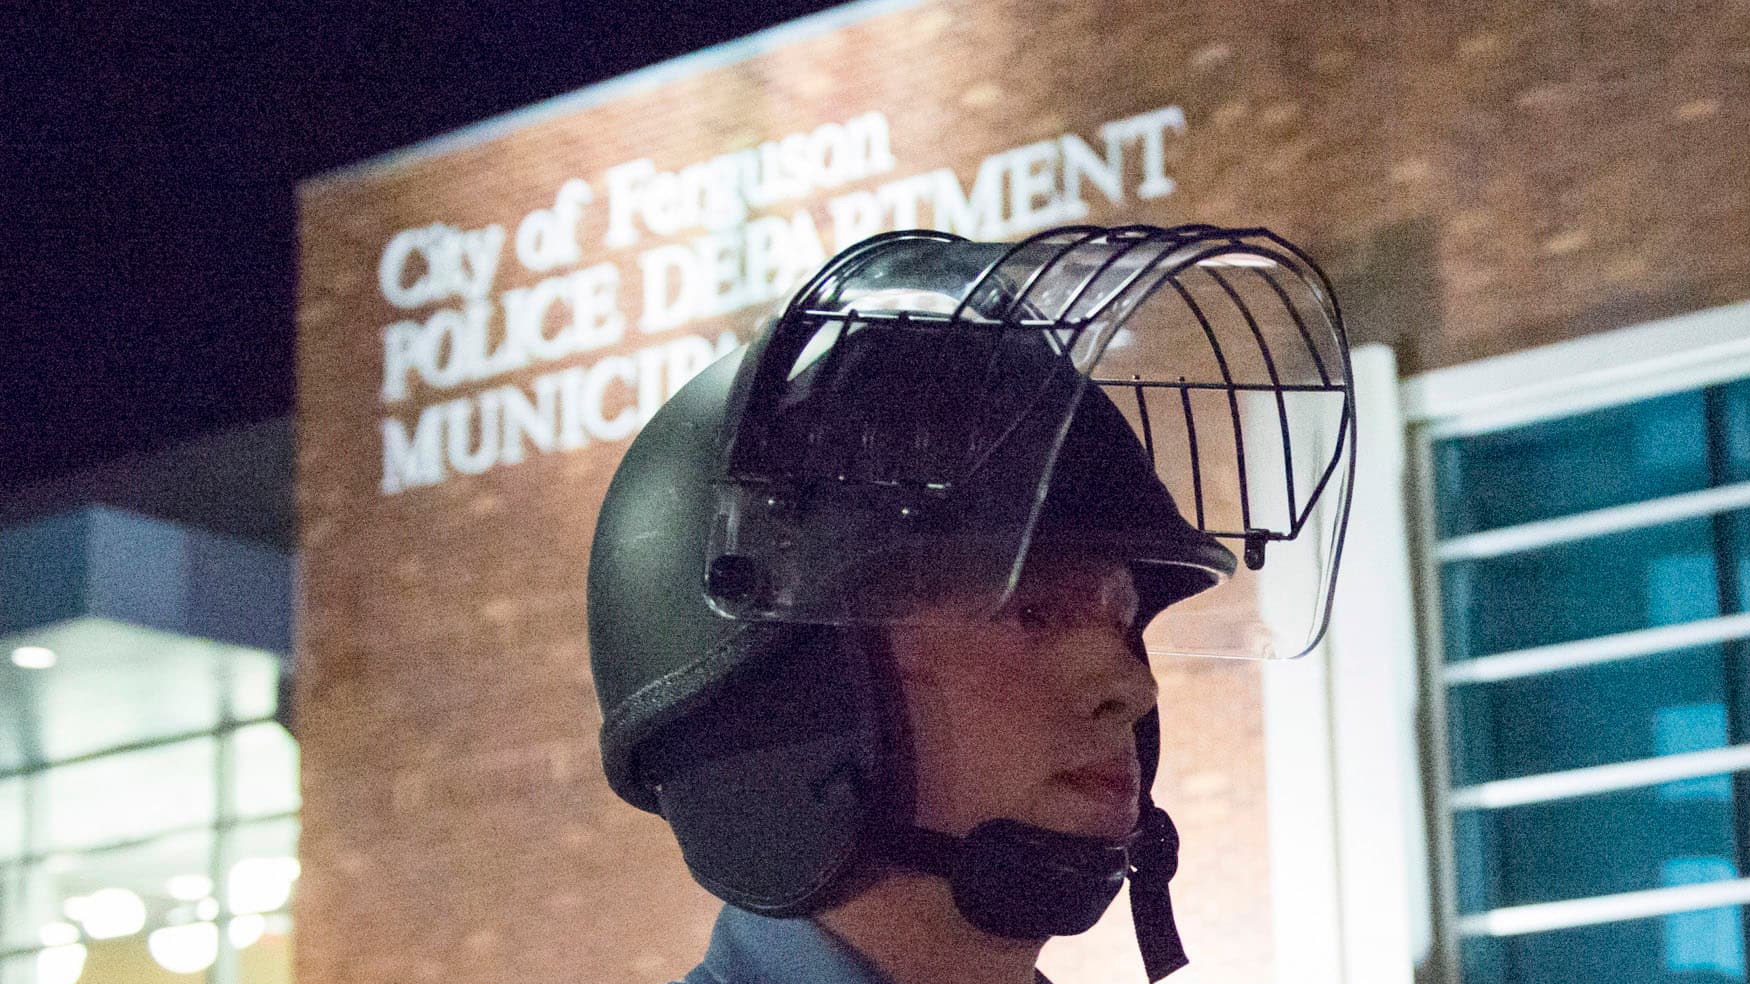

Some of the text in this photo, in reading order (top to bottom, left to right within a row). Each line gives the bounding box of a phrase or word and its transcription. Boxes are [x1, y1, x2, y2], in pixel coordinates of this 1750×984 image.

[378, 110, 897, 309] City of Ferguson
[382, 104, 1186, 403] POLICE DEPARTMENT
[381, 331, 742, 496] MUNICIP
